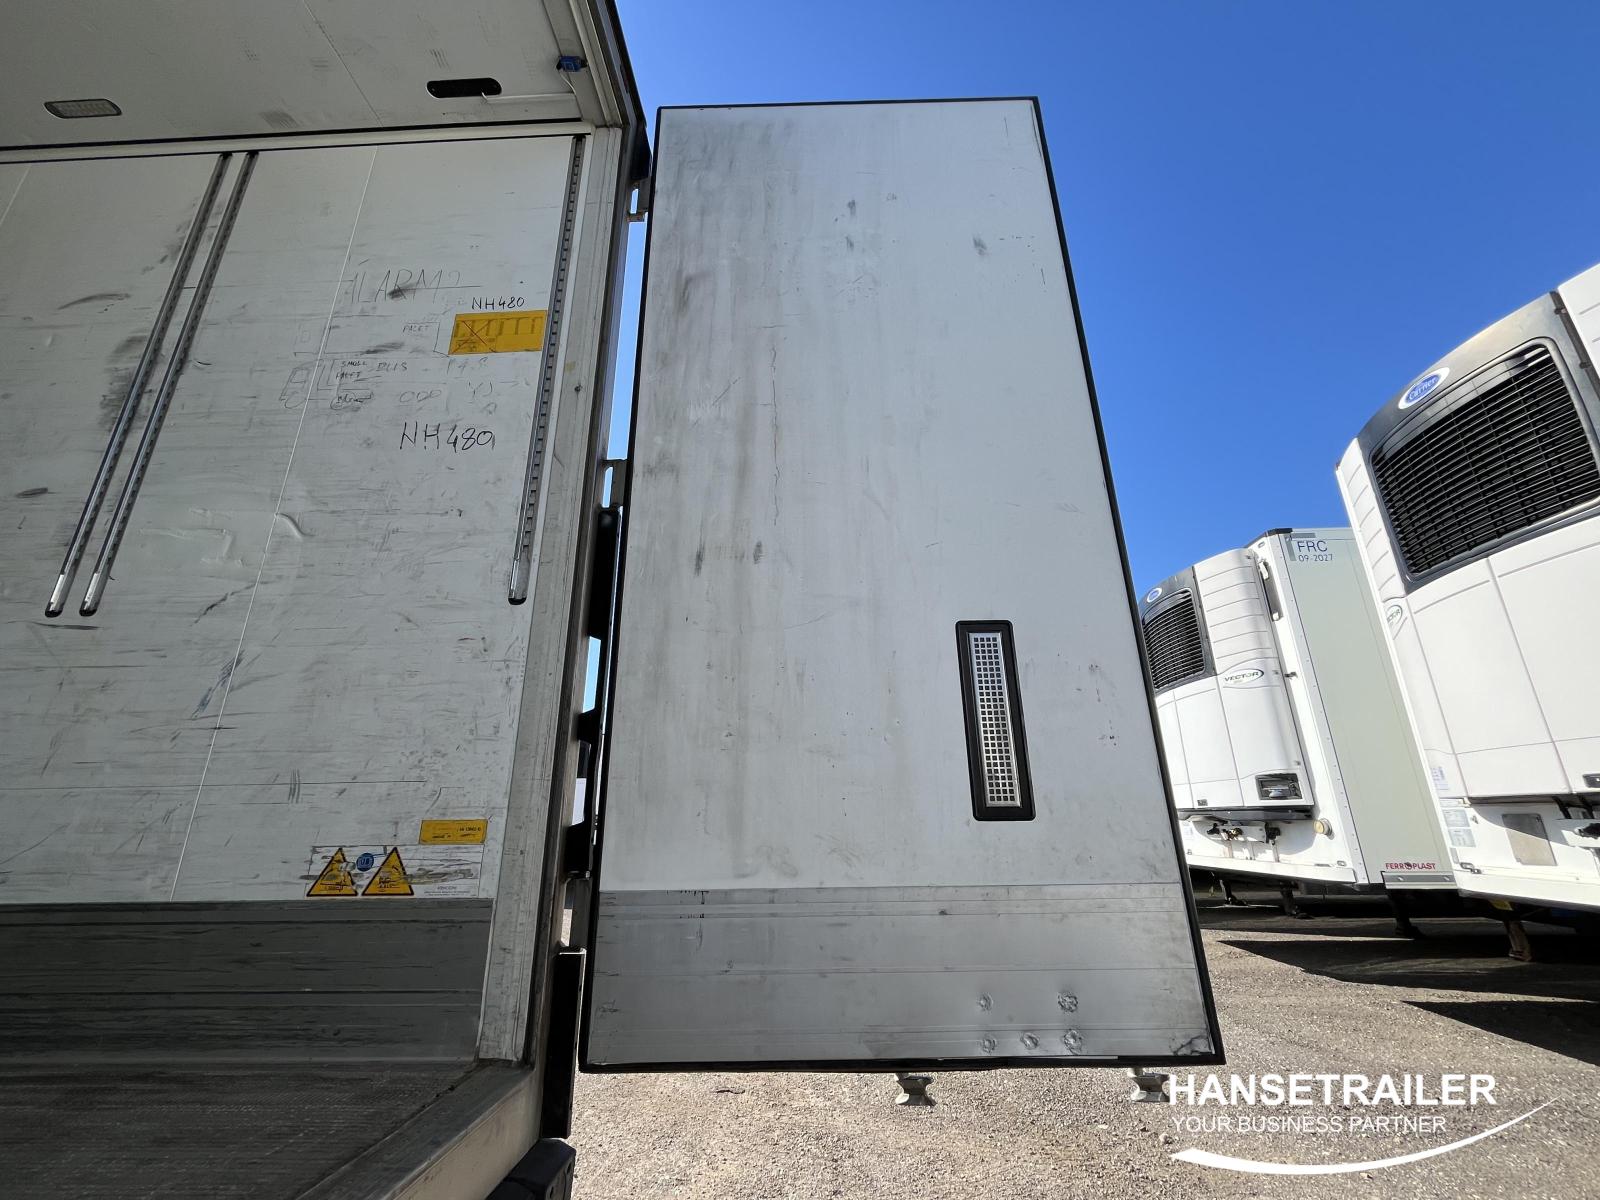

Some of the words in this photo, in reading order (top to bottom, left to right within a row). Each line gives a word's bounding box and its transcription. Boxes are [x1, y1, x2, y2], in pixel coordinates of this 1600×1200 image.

[472, 296, 525, 310] NH480
[1408, 376, 1437, 400] Carrier
[400, 421, 495, 453] NH480
[1297, 540, 1328, 552] FRC
[1298, 554, 1309, 562] 09
[1224, 671, 1259, 682] VECTOR
[1385, 862, 1436, 871] FERROPLAST
